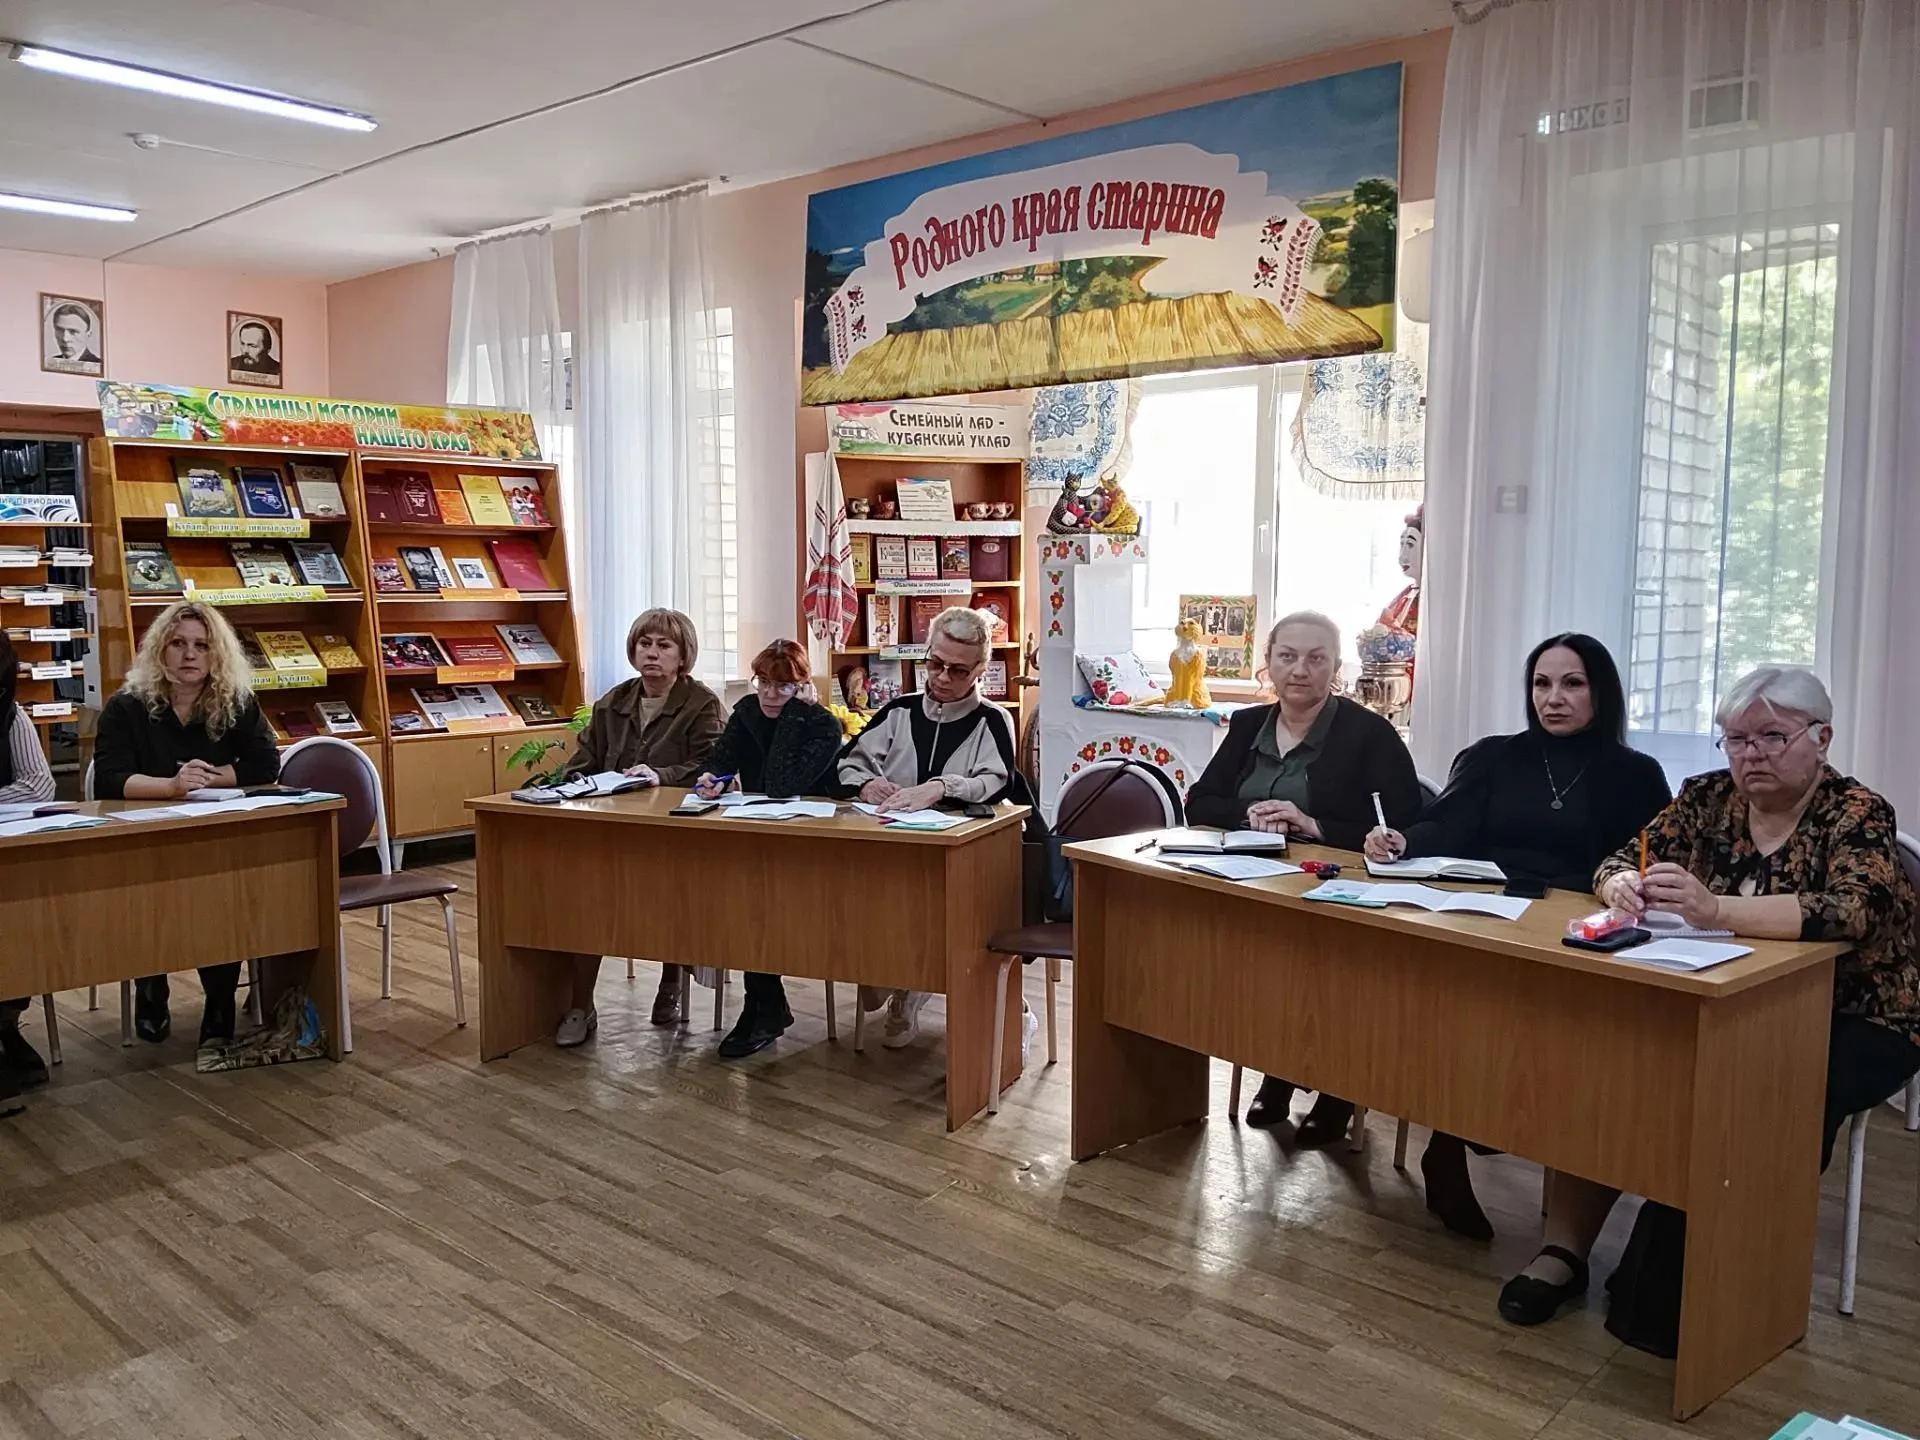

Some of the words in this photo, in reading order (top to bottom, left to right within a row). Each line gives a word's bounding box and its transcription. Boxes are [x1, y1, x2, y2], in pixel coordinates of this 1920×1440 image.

[889, 202, 1006, 291] Родного
[1012, 185, 1082, 252] края
[1086, 181, 1226, 246] старина
